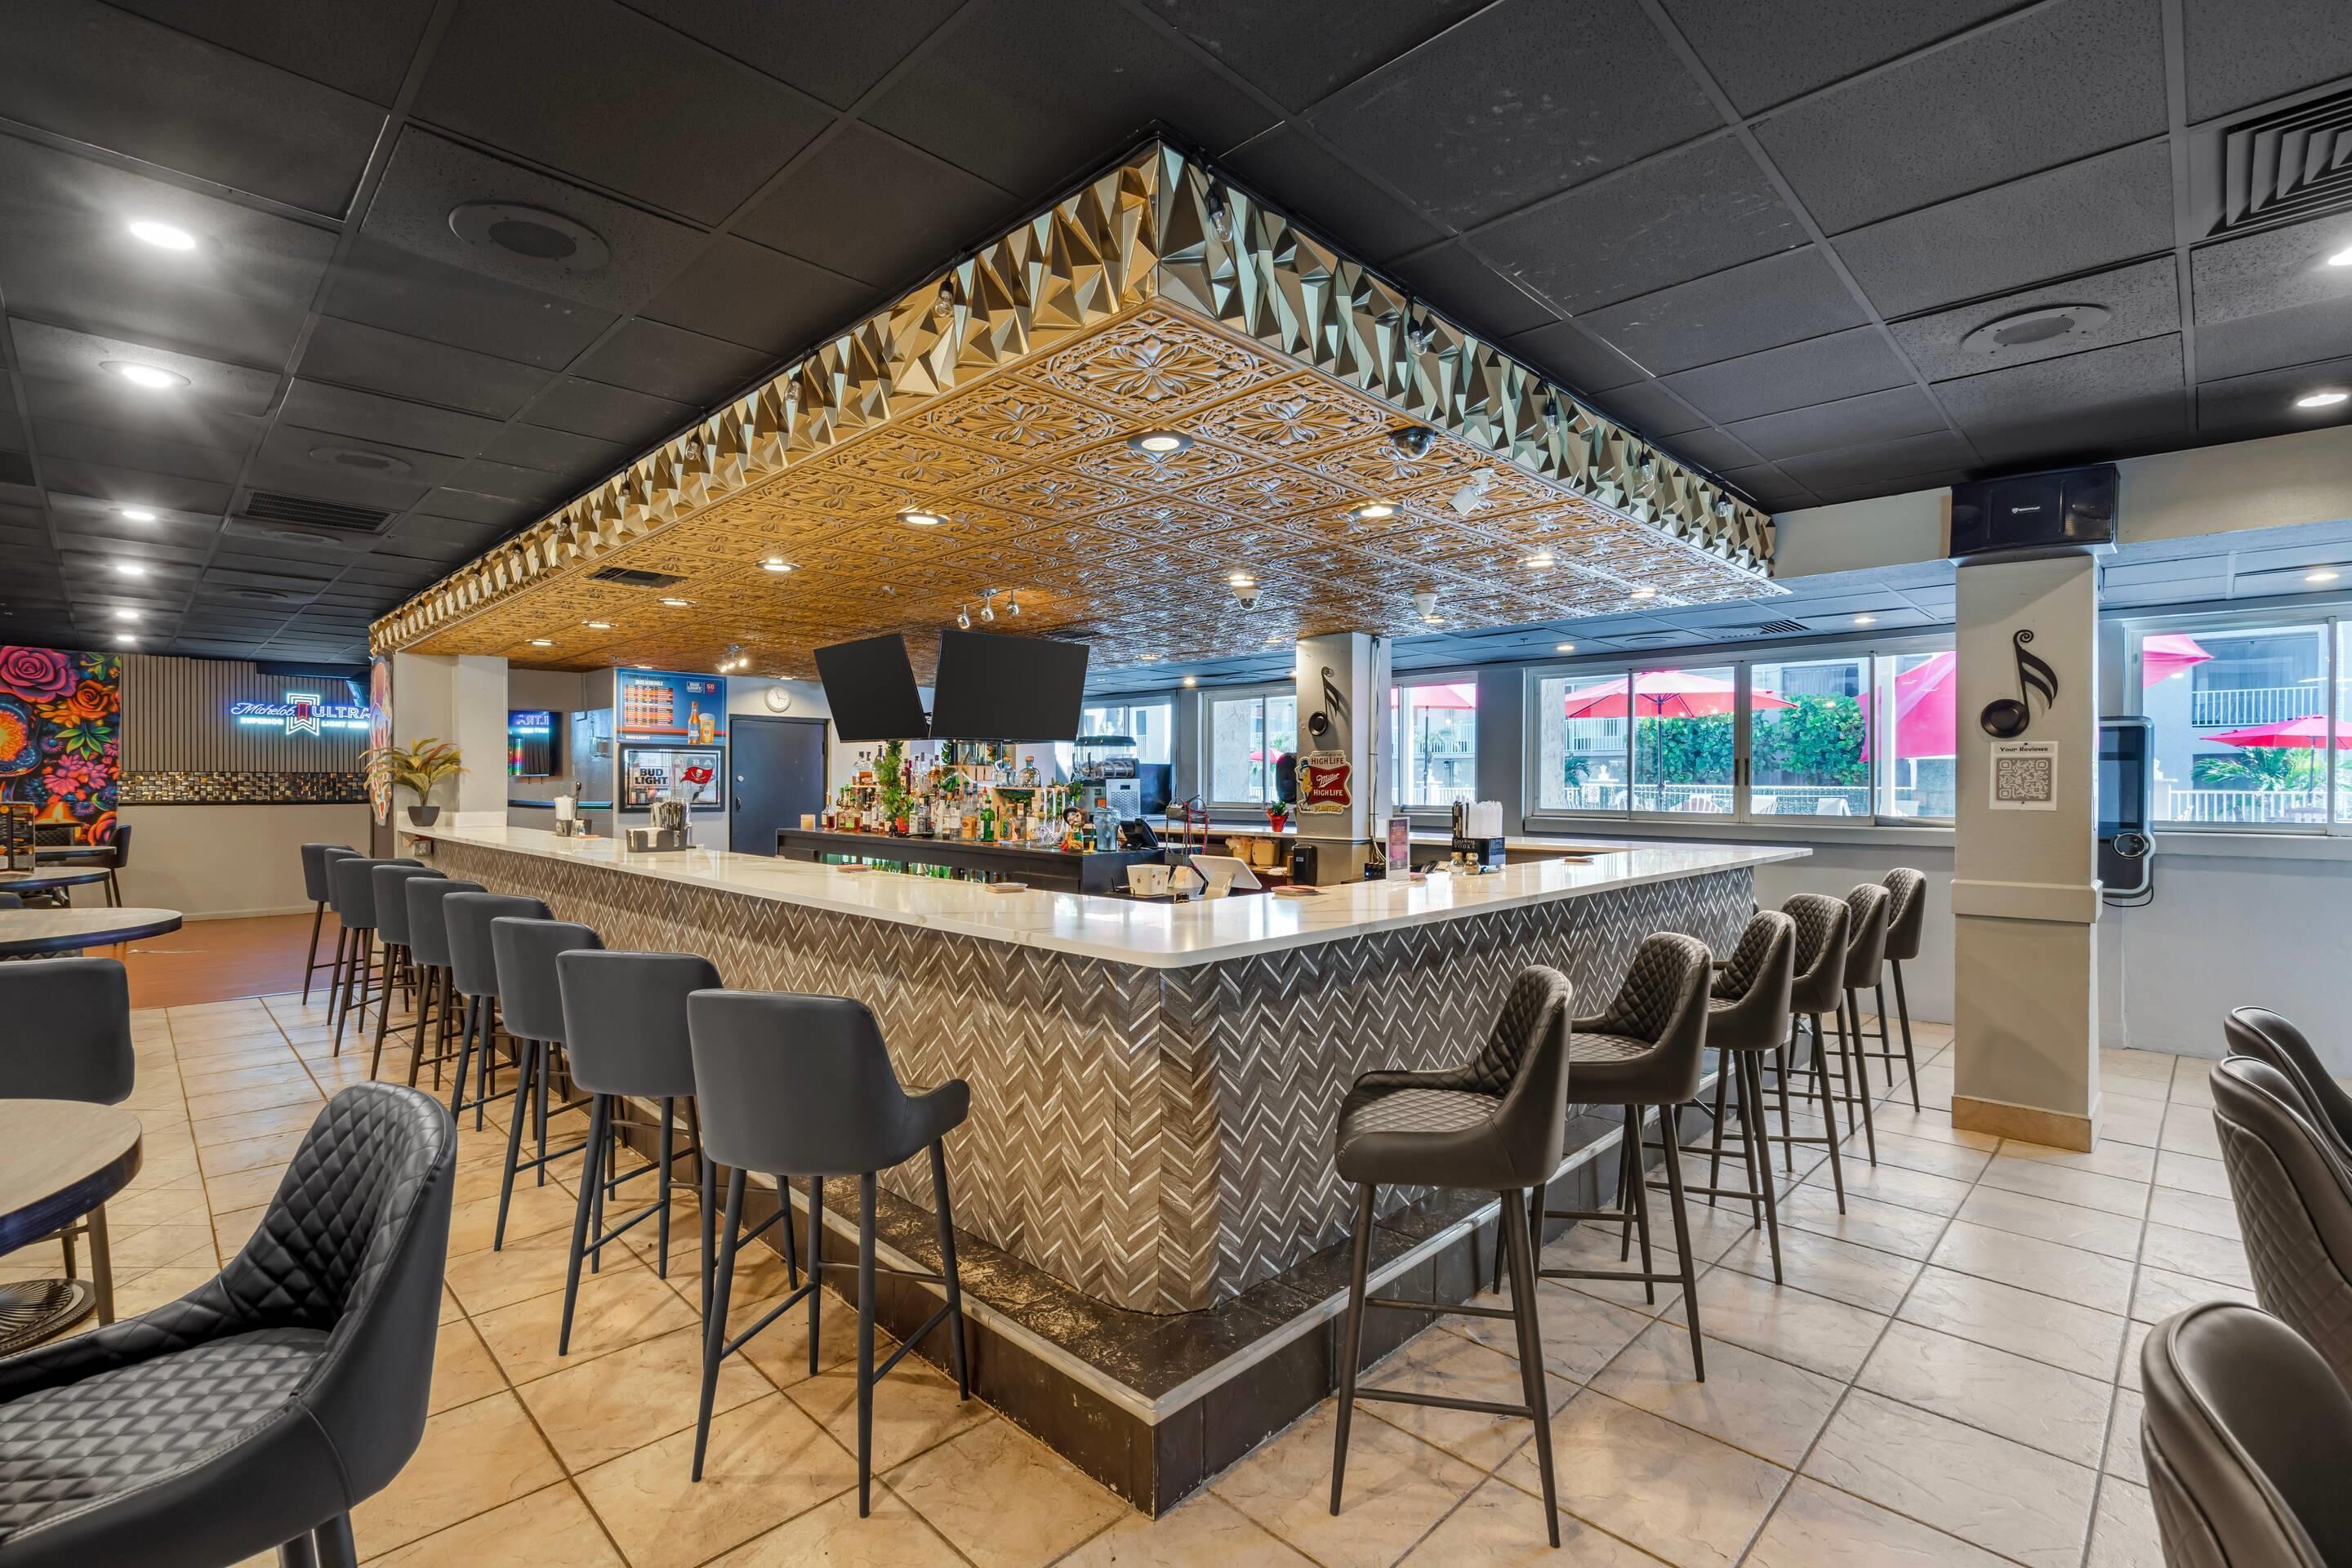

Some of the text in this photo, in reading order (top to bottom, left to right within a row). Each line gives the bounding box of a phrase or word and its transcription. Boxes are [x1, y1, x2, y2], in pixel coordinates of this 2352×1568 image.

[231, 702, 371, 719] Michelob ULTRA
[1311, 757, 1329, 765] HIGH
[639, 768, 664, 777] BUD
[635, 777, 669, 785] LIGHT
[1316, 773, 1340, 787] Miller
